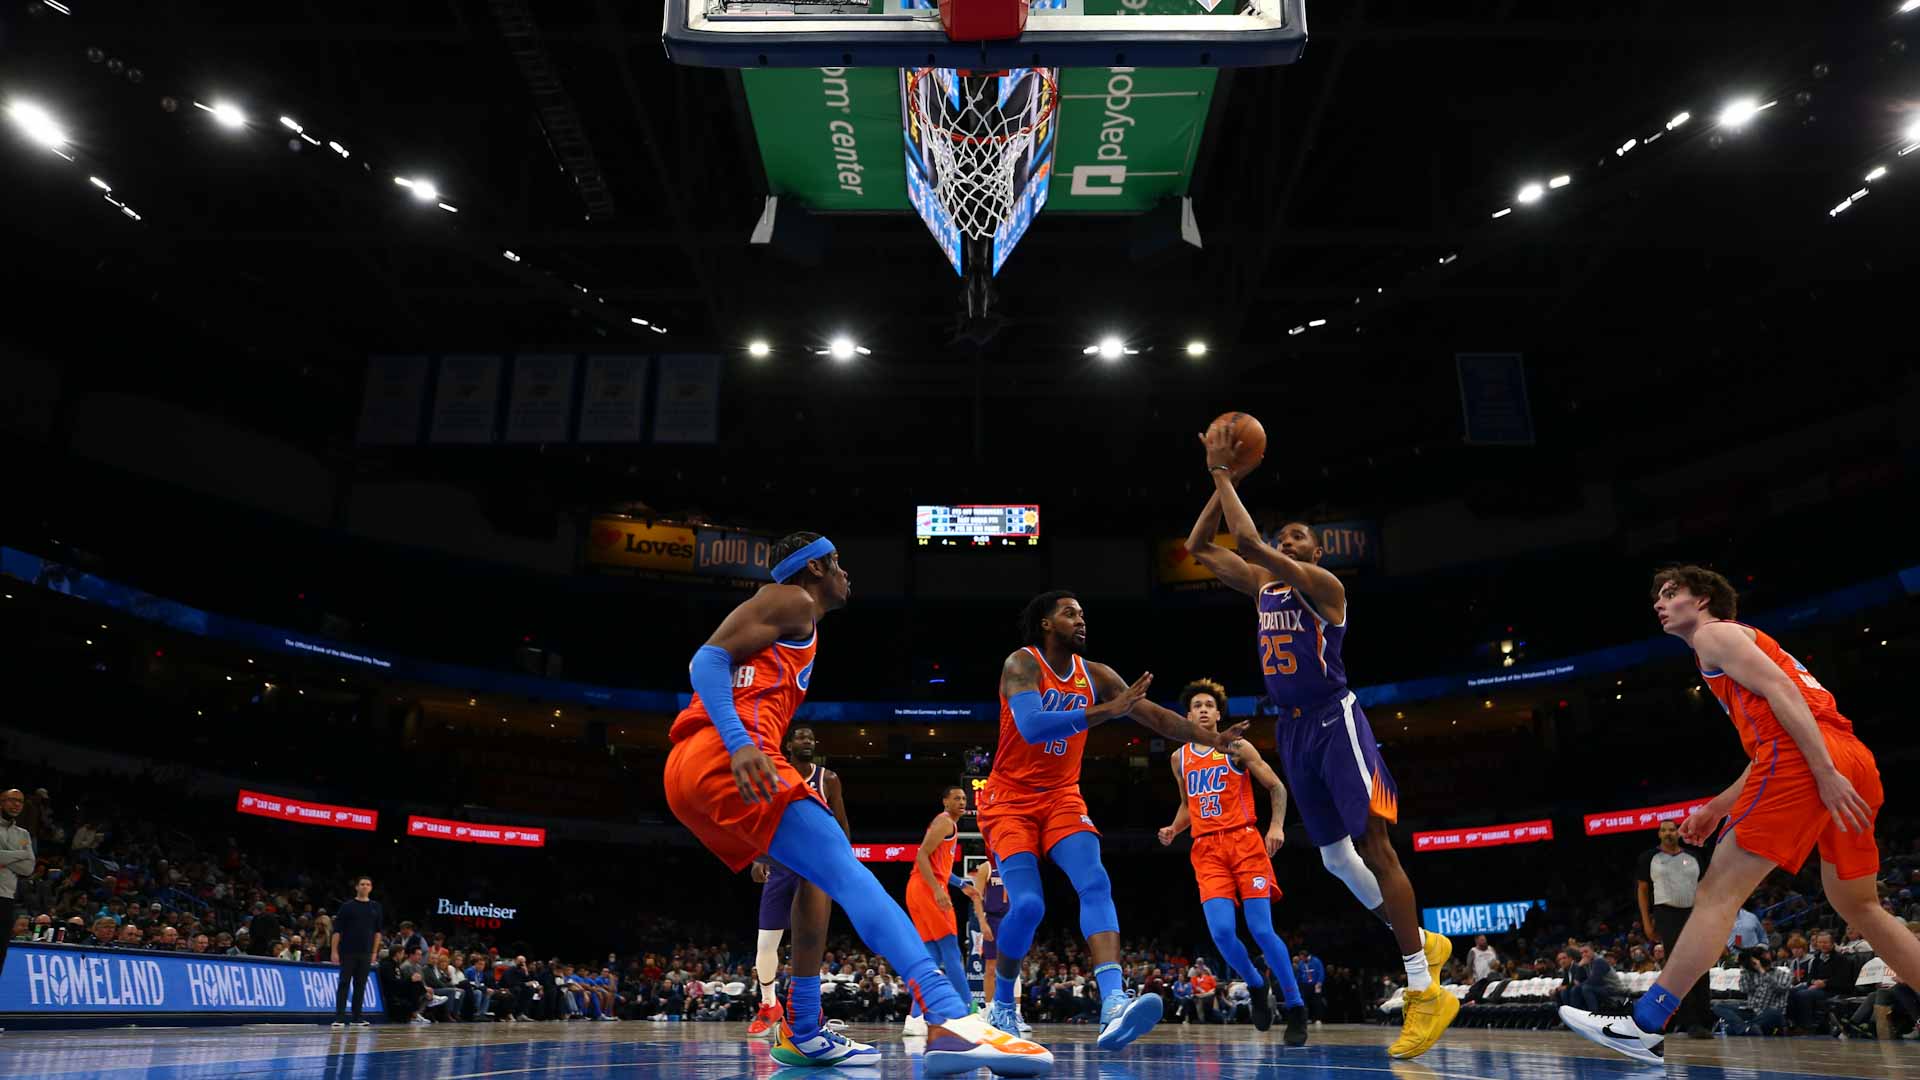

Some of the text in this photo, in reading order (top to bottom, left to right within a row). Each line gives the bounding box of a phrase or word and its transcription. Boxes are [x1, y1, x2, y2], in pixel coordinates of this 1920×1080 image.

[1097, 67, 1136, 160] payco
[829, 120, 865, 195] center
[700, 540, 771, 568] LOUD CI
[1323, 528, 1366, 556] CITY
[1260, 634, 1298, 676] 25
[1044, 738, 1068, 756] 15
[1187, 765, 1230, 797] OKC
[1200, 793, 1222, 818] 23
[436, 898, 517, 919] Budweiser
[26, 954, 165, 1006] HOMELAND
[187, 963, 286, 1007] HOMELAND
